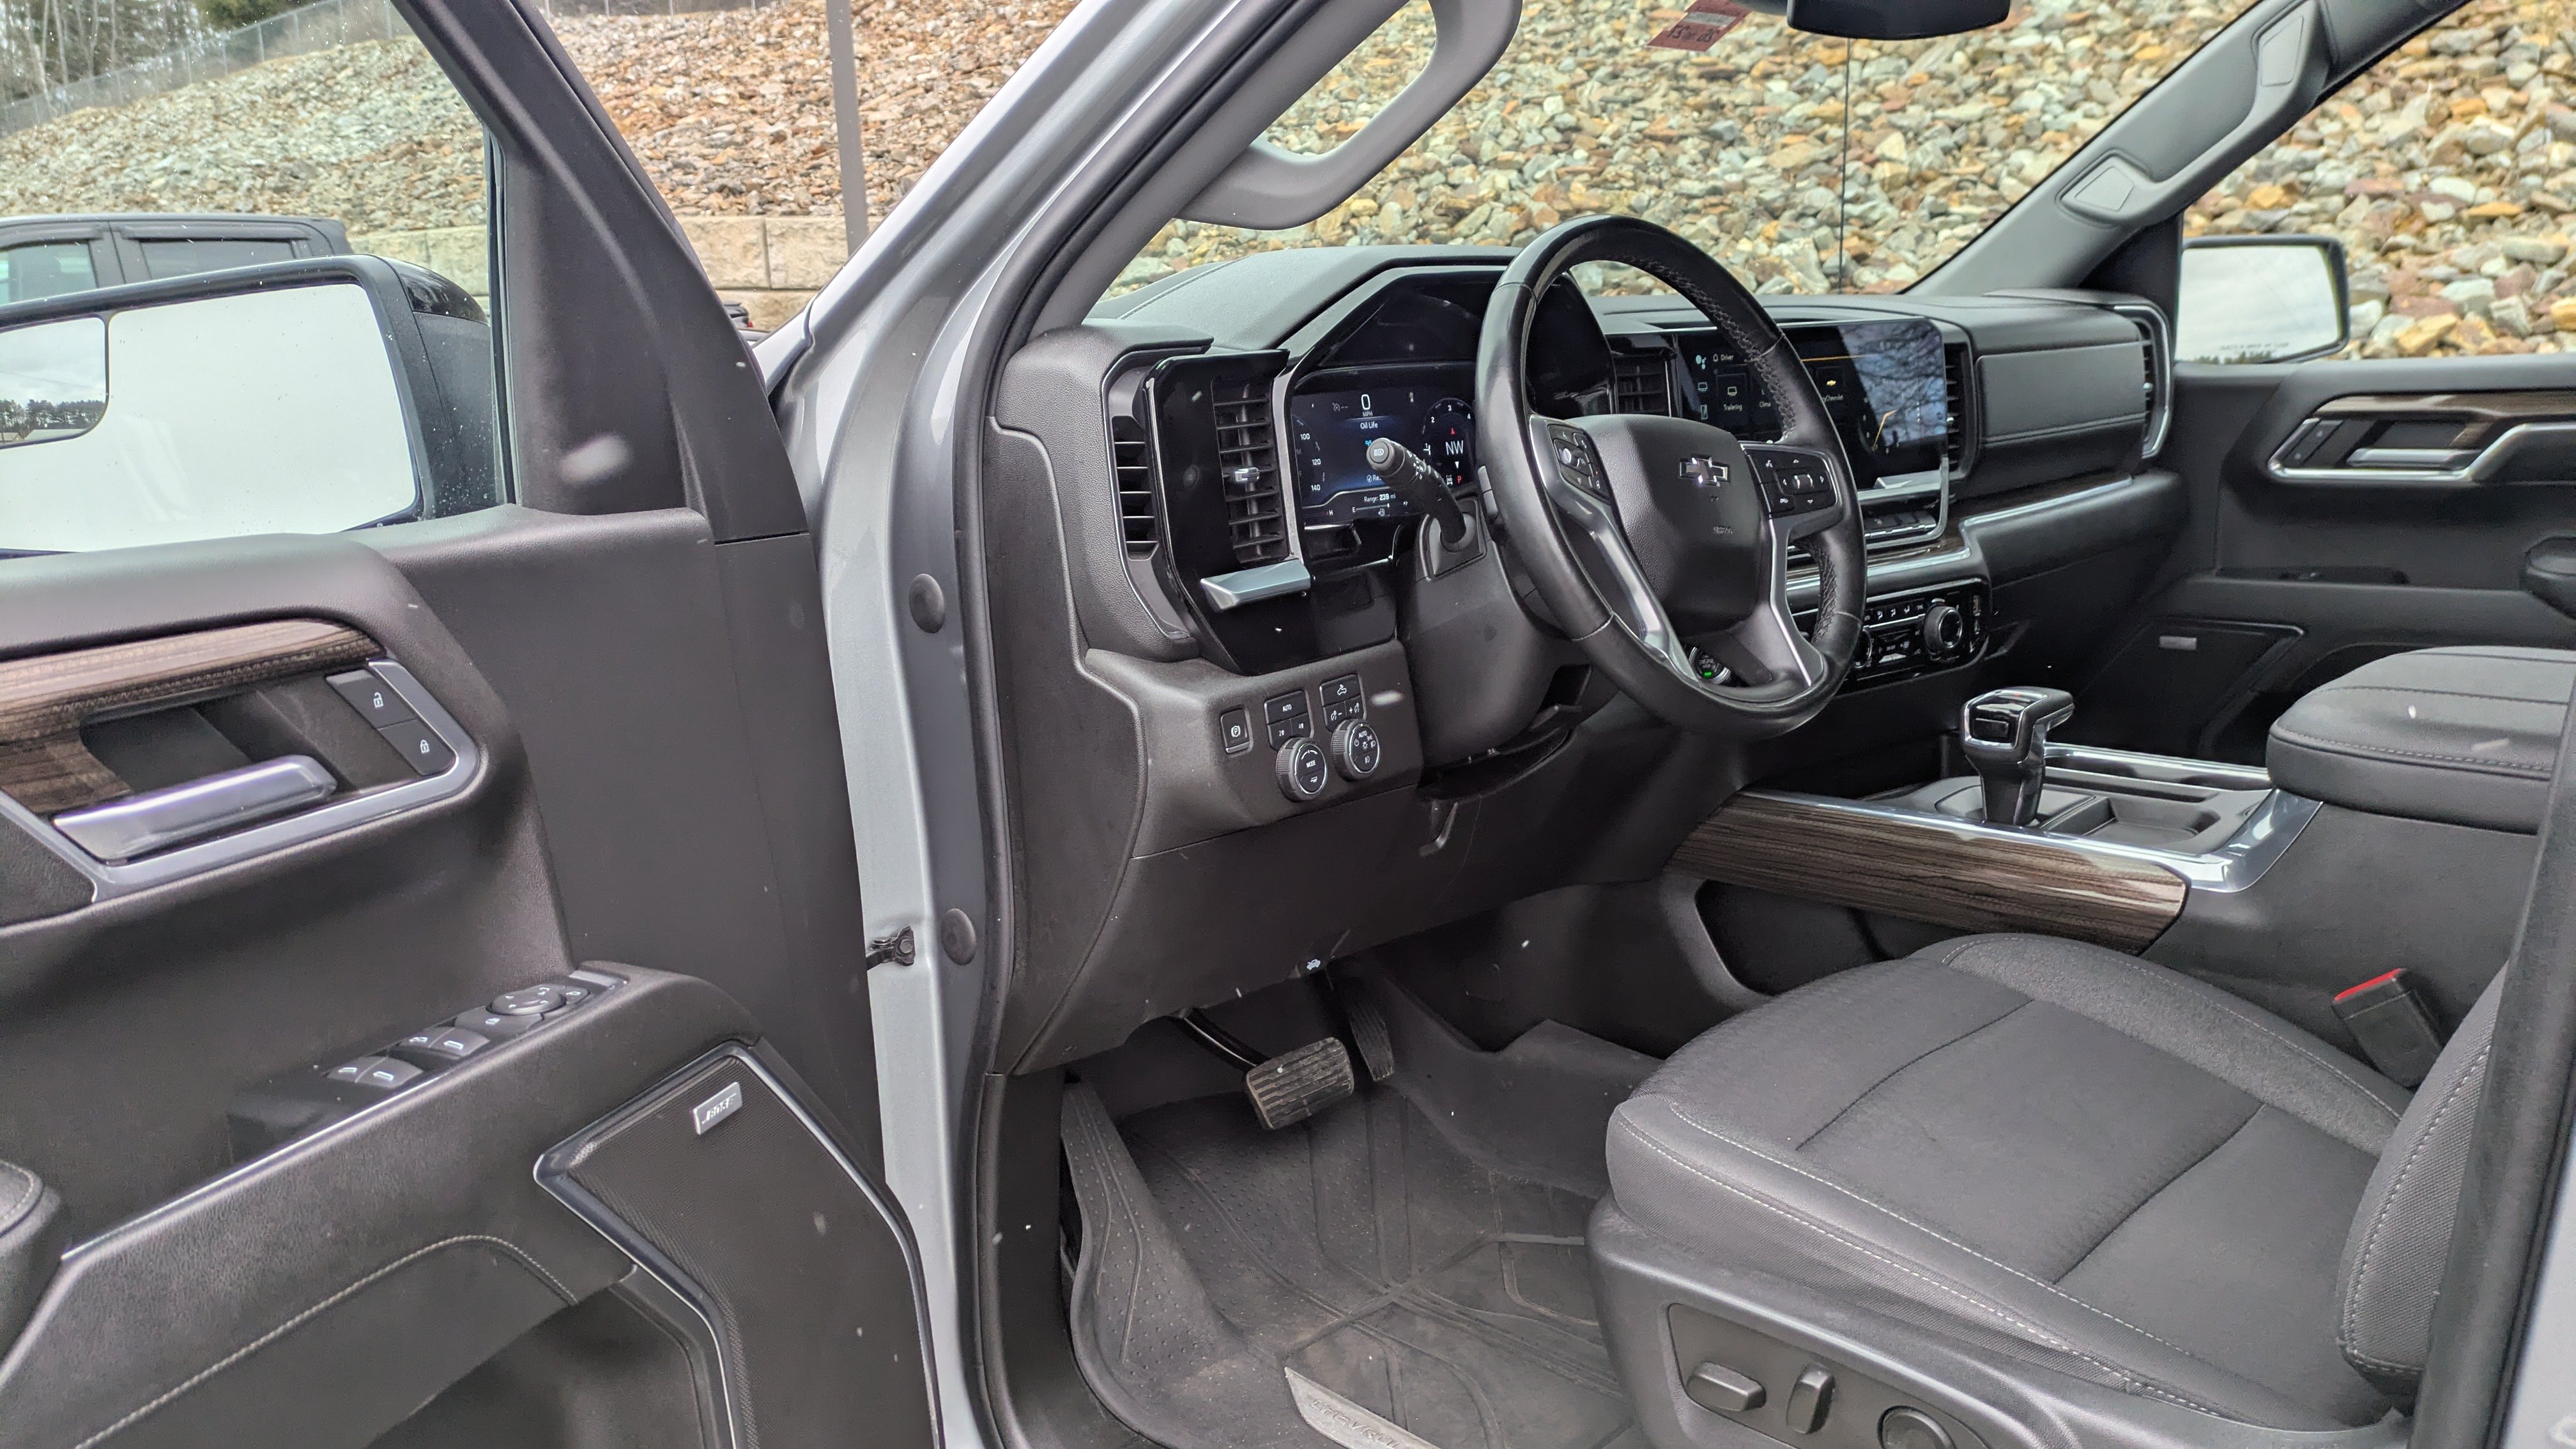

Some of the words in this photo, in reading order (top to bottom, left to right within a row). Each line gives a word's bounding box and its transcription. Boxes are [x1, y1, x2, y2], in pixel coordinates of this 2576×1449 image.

[1361, 394, 1371, 410] 0
[1445, 440, 1464, 456] NW
[1457, 475, 1462, 484] P
